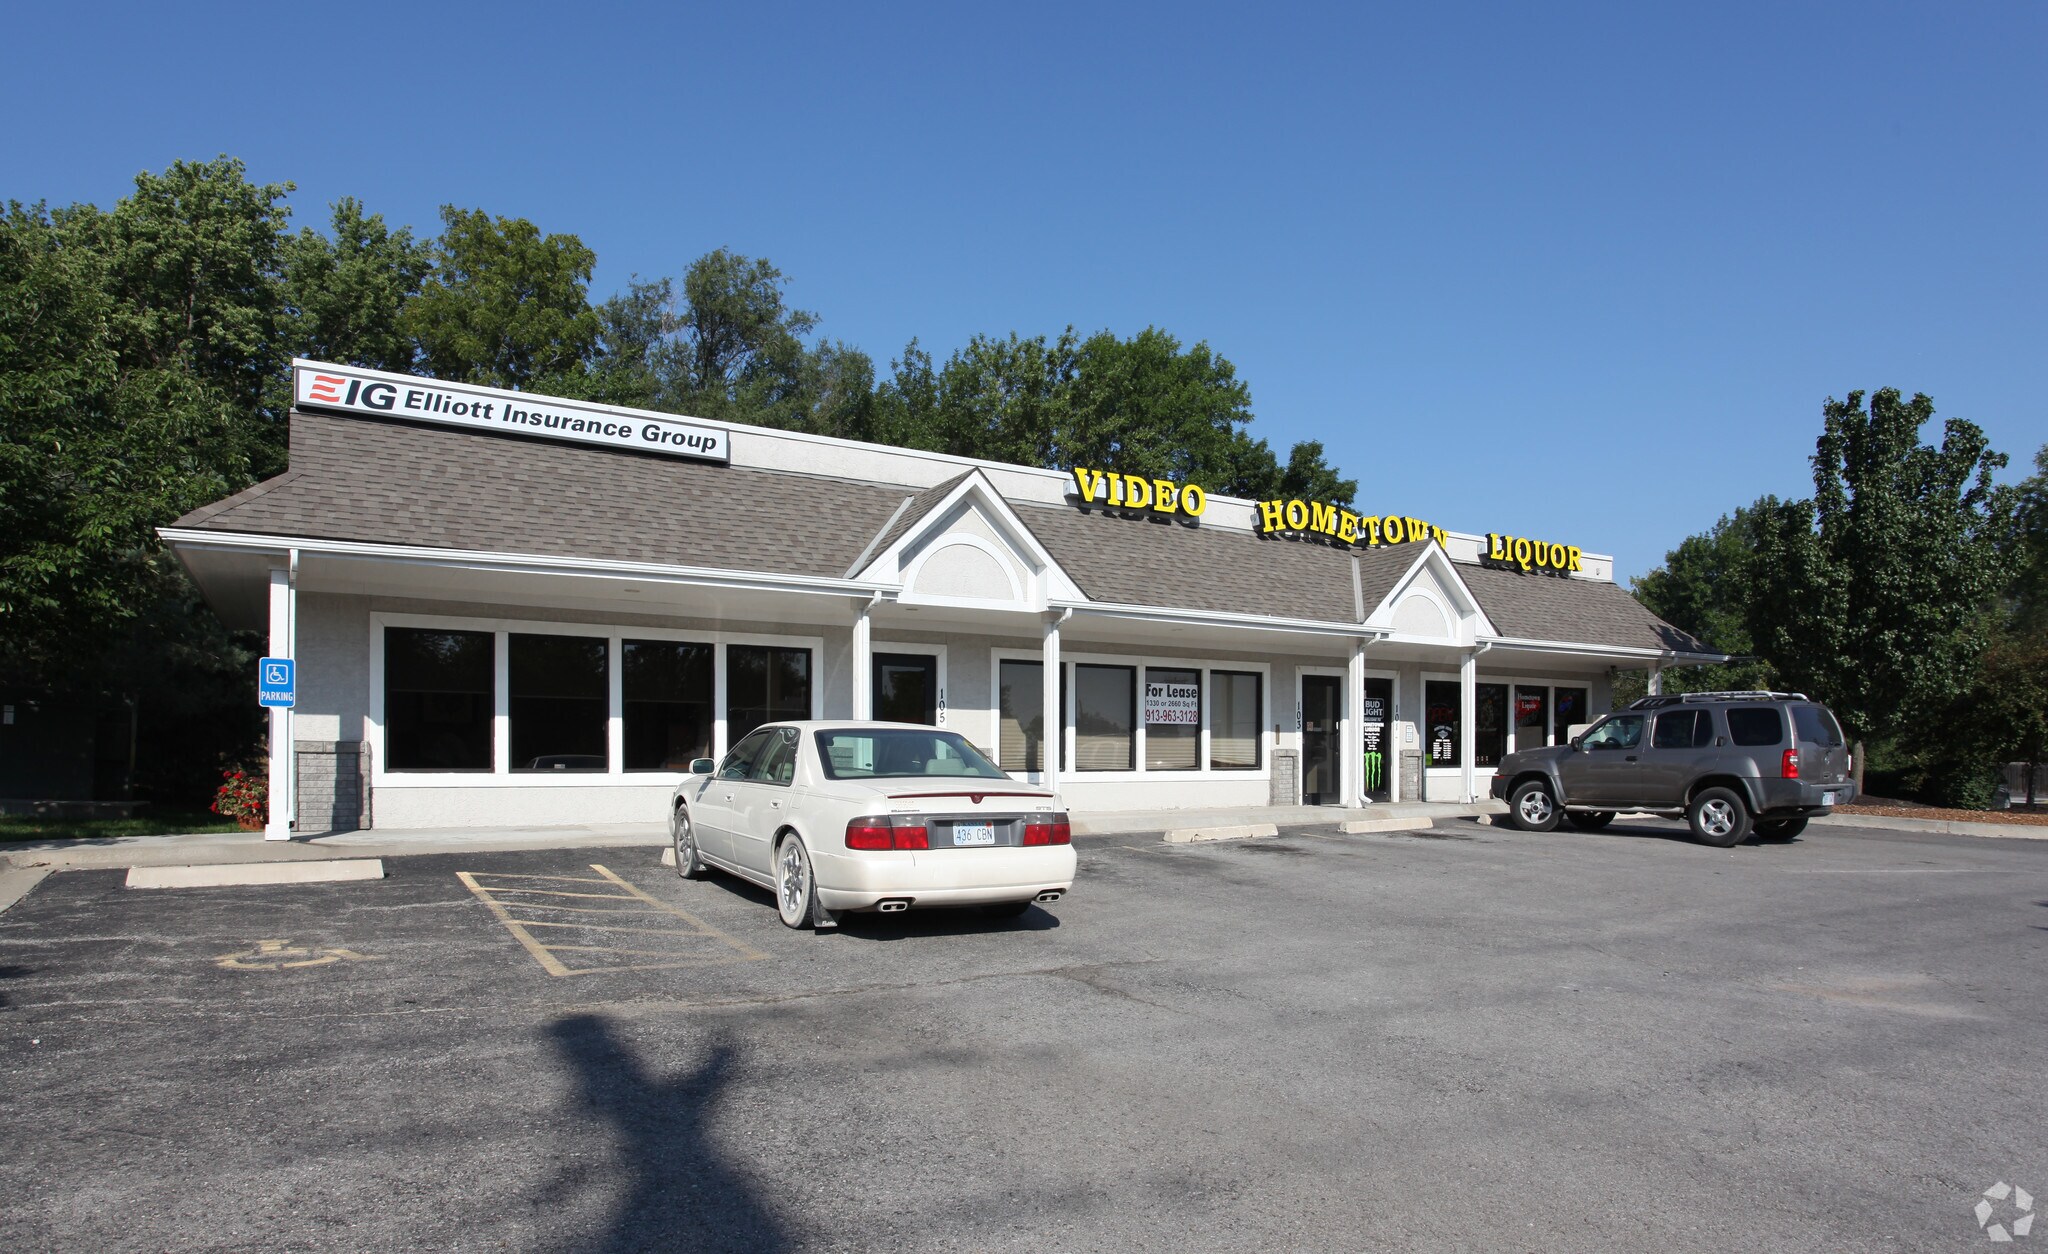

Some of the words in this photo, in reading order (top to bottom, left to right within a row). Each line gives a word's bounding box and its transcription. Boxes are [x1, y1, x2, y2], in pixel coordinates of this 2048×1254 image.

[309, 375, 398, 411] EIG
[404, 389, 495, 420] Elliott
[502, 403, 633, 438] Insurance
[641, 424, 718, 453] Group
[1074, 466, 1207, 518] VIDEO
[1489, 532, 1584, 571] LIQUOR
[261, 690, 294, 702] PARKING
[1146, 683, 1163, 698] For
[1167, 684, 1197, 698] Lease
[938, 687, 946, 724] 105
[1182, 700, 1190, 708] Sq
[1365, 700, 1381, 709] BUD
[1146, 709, 1198, 722] 913-963-3128
[956, 829, 972, 841] 436
